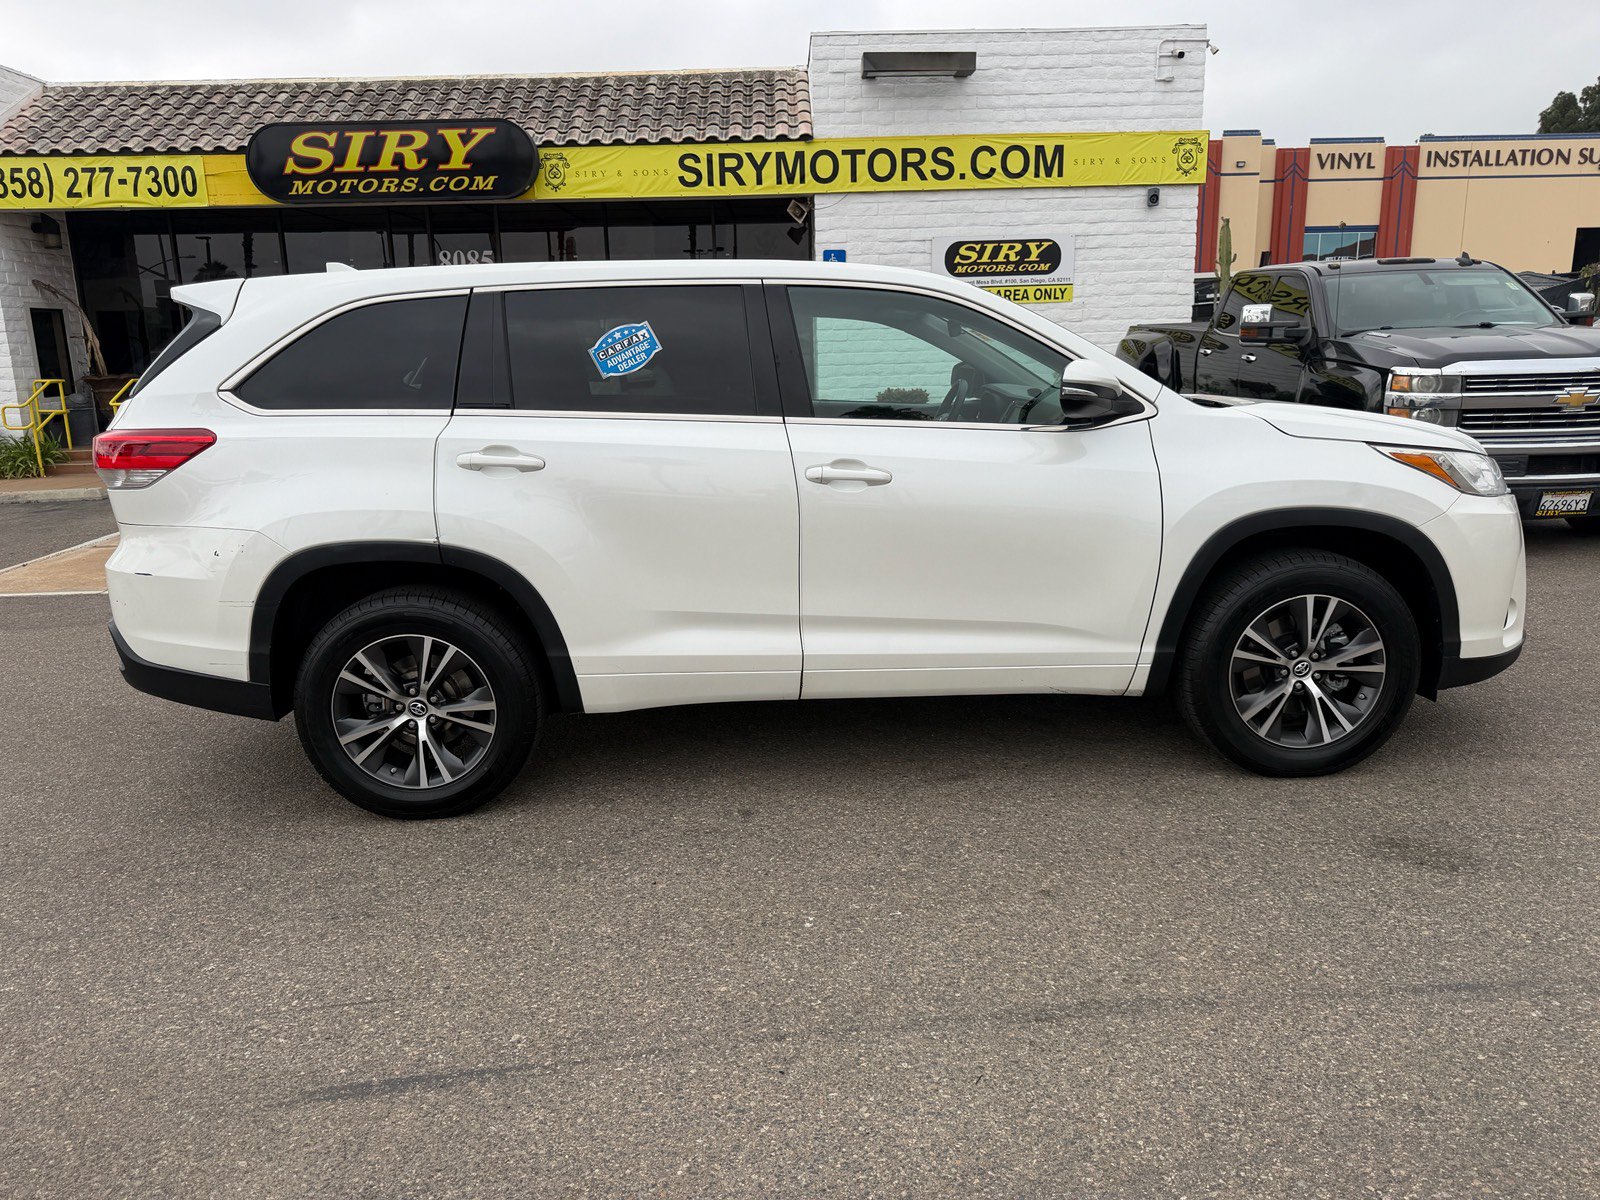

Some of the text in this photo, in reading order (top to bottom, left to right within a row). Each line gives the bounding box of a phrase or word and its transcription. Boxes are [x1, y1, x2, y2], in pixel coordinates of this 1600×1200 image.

[282, 126, 496, 175] SIRY
[1426, 148, 1571, 167] INSTALLATION
[677, 144, 1065, 188] SIRYMOTORS.COM
[1073, 156, 1167, 166] SIRY & SONS
[1316, 151, 1376, 170] VINYL
[63, 165, 198, 199] 277-7300
[575, 168, 669, 178] SIRY & SONS
[288, 175, 498, 195] MOTORS.COM
[439, 250, 494, 265] 8085
[953, 241, 1054, 263] SIRY
[953, 263, 1052, 273] MOTORS.COM
[995, 287, 1068, 301] AREA ONLY
[598, 331, 648, 360] CARFAX
[606, 341, 651, 368] ADVANTAGE
[617, 352, 648, 372] DEALER
[1540, 499, 1587, 511] 62696Y3
